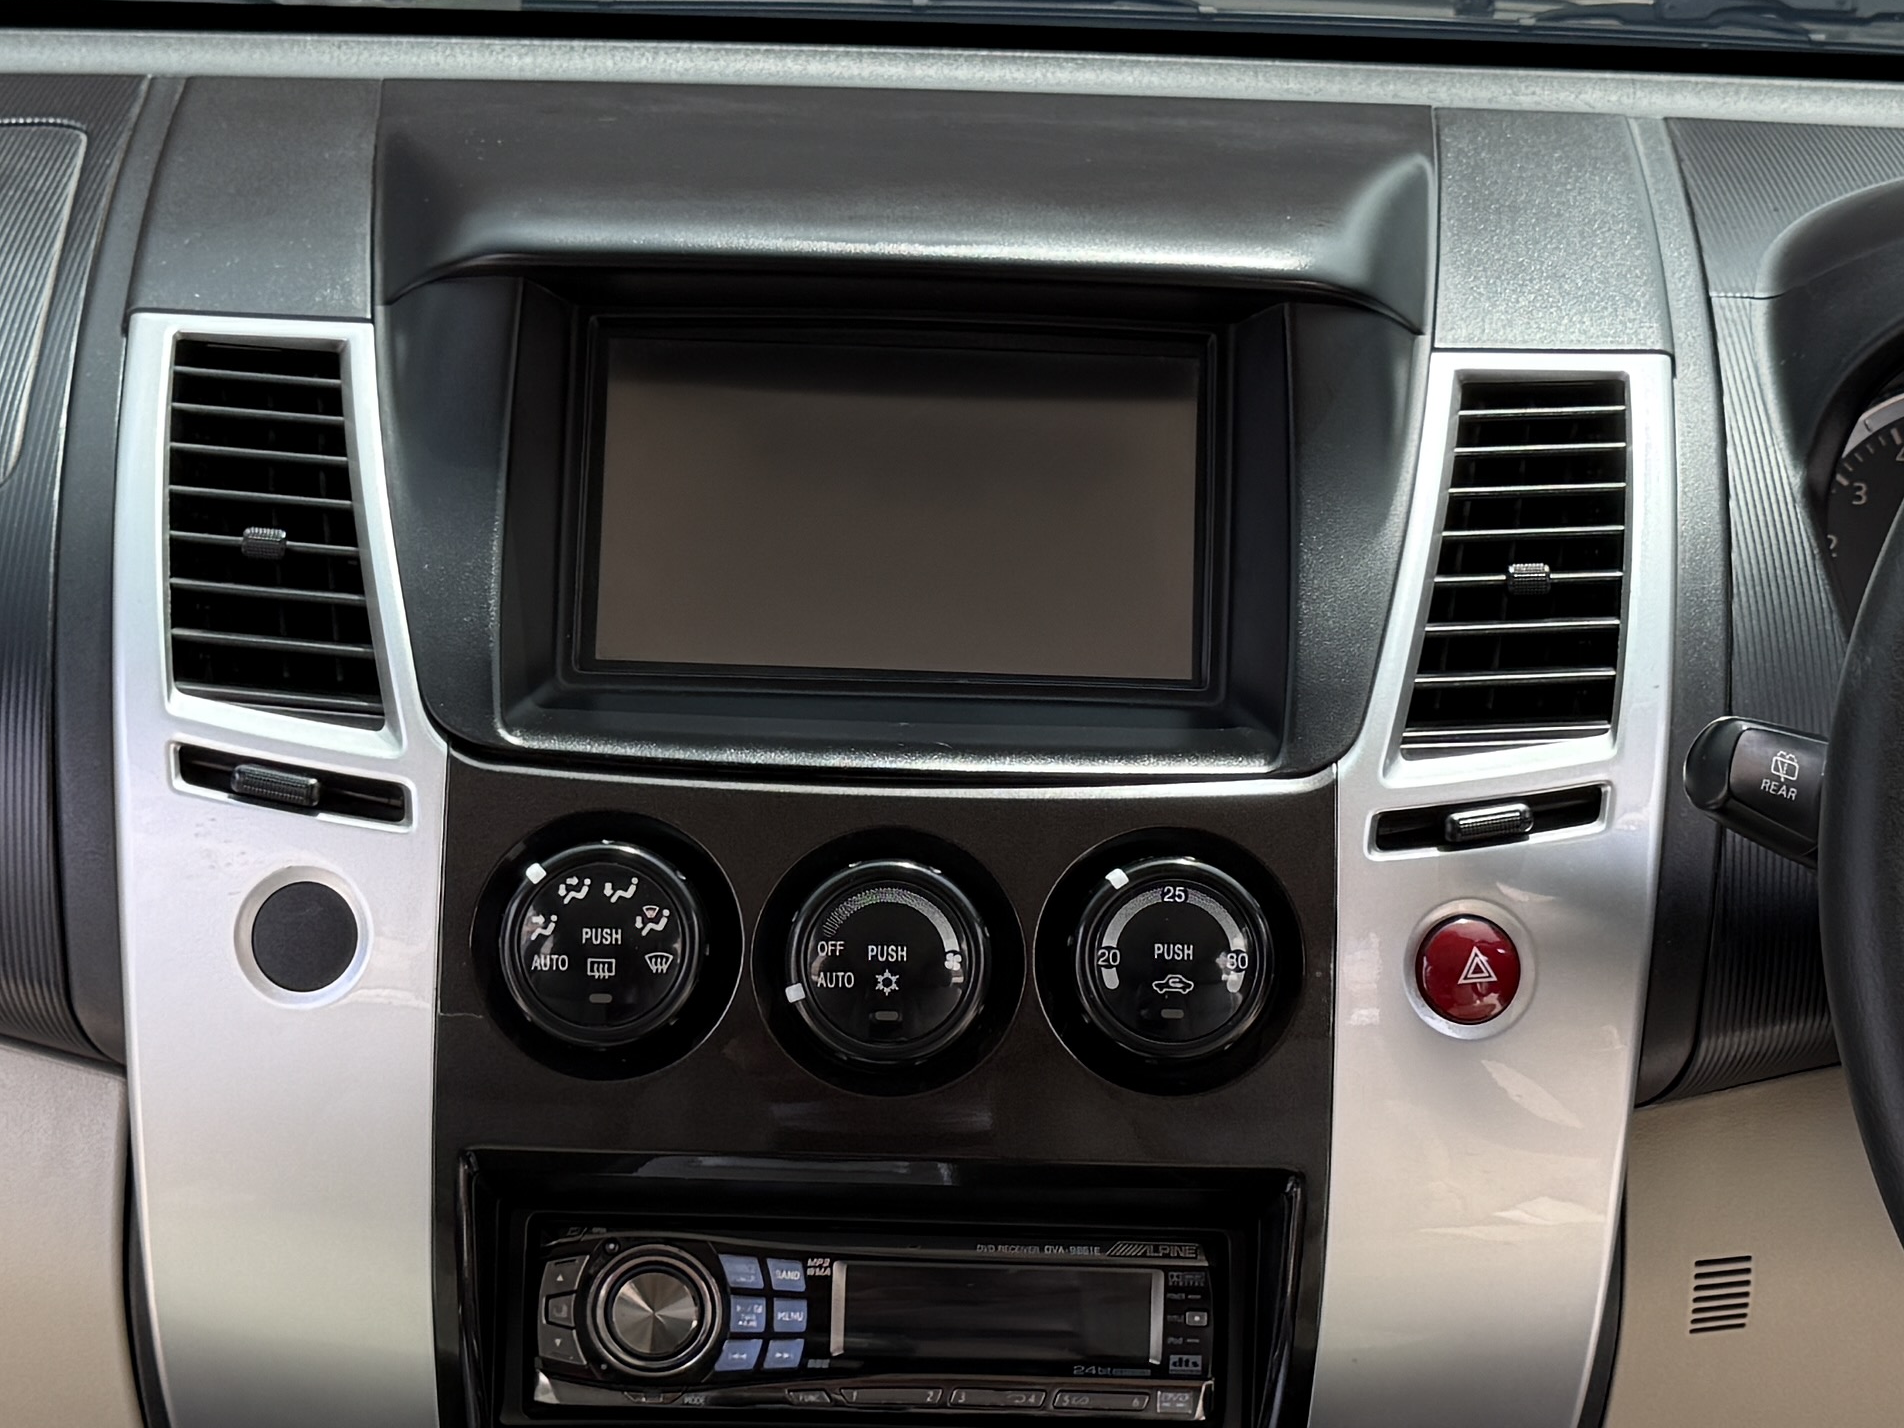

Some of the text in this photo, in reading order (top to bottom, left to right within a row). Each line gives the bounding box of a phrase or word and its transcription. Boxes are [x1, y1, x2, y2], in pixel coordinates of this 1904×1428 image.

[1852, 482, 1868, 506] 3
[1760, 778, 1798, 801] REAR
[1162, 886, 1186, 903] 25
[581, 927, 622, 945] PUSH
[817, 940, 845, 957] OFF
[867, 944, 908, 962] PUSH
[1154, 943, 1194, 961] PUSH
[531, 954, 569, 971] AUTO
[1096, 949, 1121, 966] 20
[817, 972, 855, 988] AUTO
[775, 1268, 801, 1281] BAND
[1171, 1355, 1200, 1369] dts
[926, 1391, 934, 1402] 2
[958, 1392, 967, 1403] 3
[1027, 1393, 1036, 1404] 4
